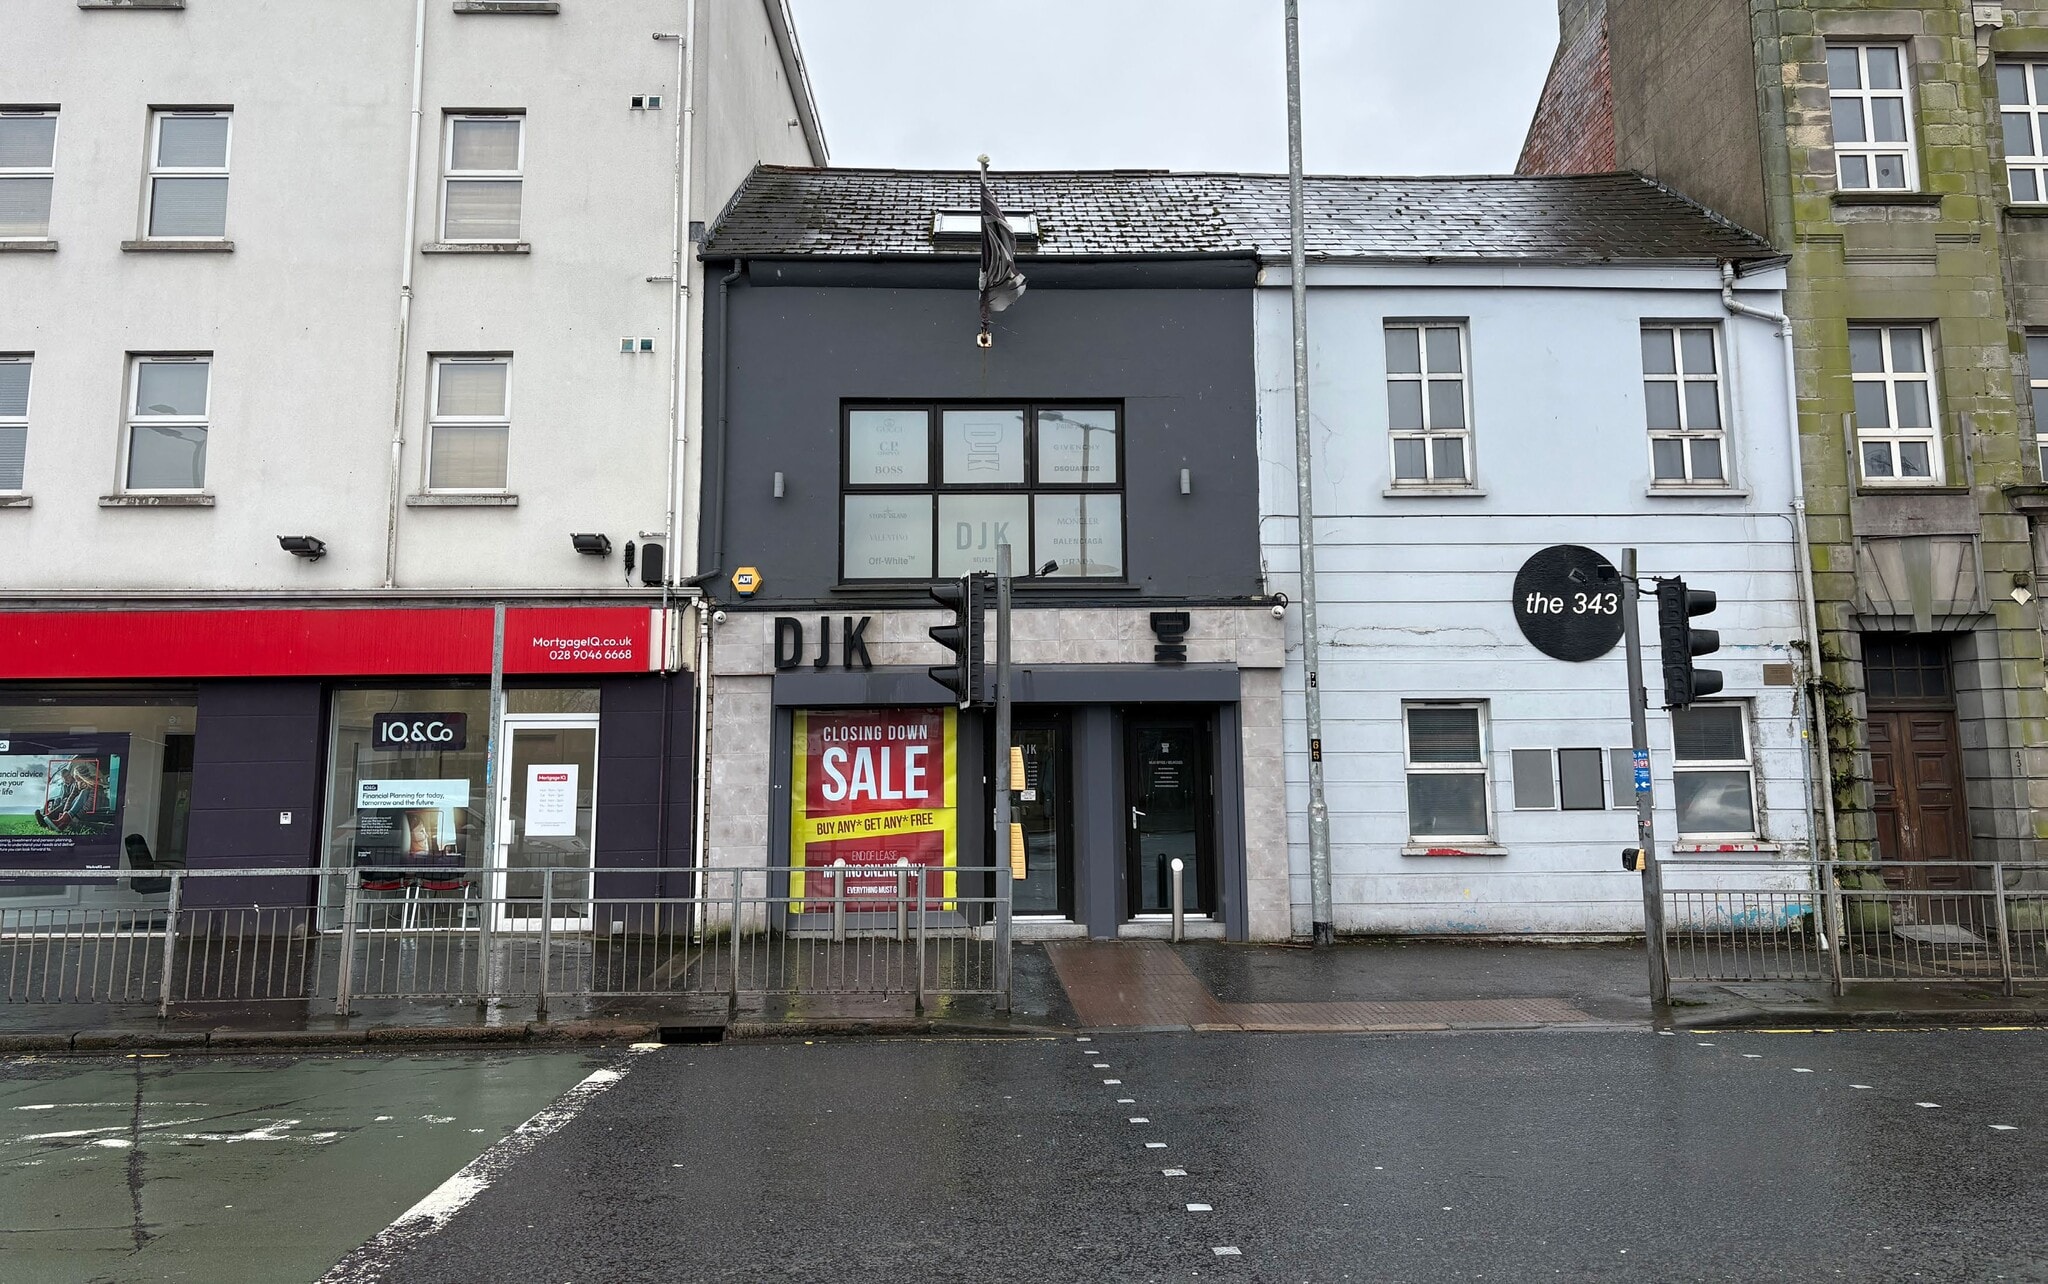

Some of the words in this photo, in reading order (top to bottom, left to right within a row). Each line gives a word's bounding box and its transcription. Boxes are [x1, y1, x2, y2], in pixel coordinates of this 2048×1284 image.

[875, 465, 904, 474] BOSS
[1057, 517, 1100, 525] MONCLER
[956, 521, 1010, 550] DJK
[1053, 537, 1103, 545] BALENCIAGA
[738, 575, 753, 584] ADT
[1526, 592, 1564, 614] the
[1572, 592, 1618, 615] 343
[532, 635, 633, 649] MortgageIQ.co.uk
[774, 615, 873, 669] DJK
[549, 650, 571, 660] 028
[573, 650, 602, 660] 9046
[604, 649, 632, 660] 6668
[823, 725, 882, 741] CLOSING
[888, 724, 928, 740] DOWN
[1312, 740, 1320, 761] 65
[19, 770, 44, 778] advice
[822, 745, 929, 802] SALE
[8, 780, 25, 788] your
[2, 788, 14, 796] life
[362, 792, 389, 800] Financial
[389, 792, 415, 800] Planning
[816, 822, 836, 836] BUY
[864, 816, 882, 831] GET
[911, 812, 934, 827] FREE
[852, 851, 865, 860] END
[866, 851, 874, 860] OF
[875, 850, 897, 860] LEASE
[823, 864, 862, 878] MING
[847, 886, 878, 894] EVERYTHING
